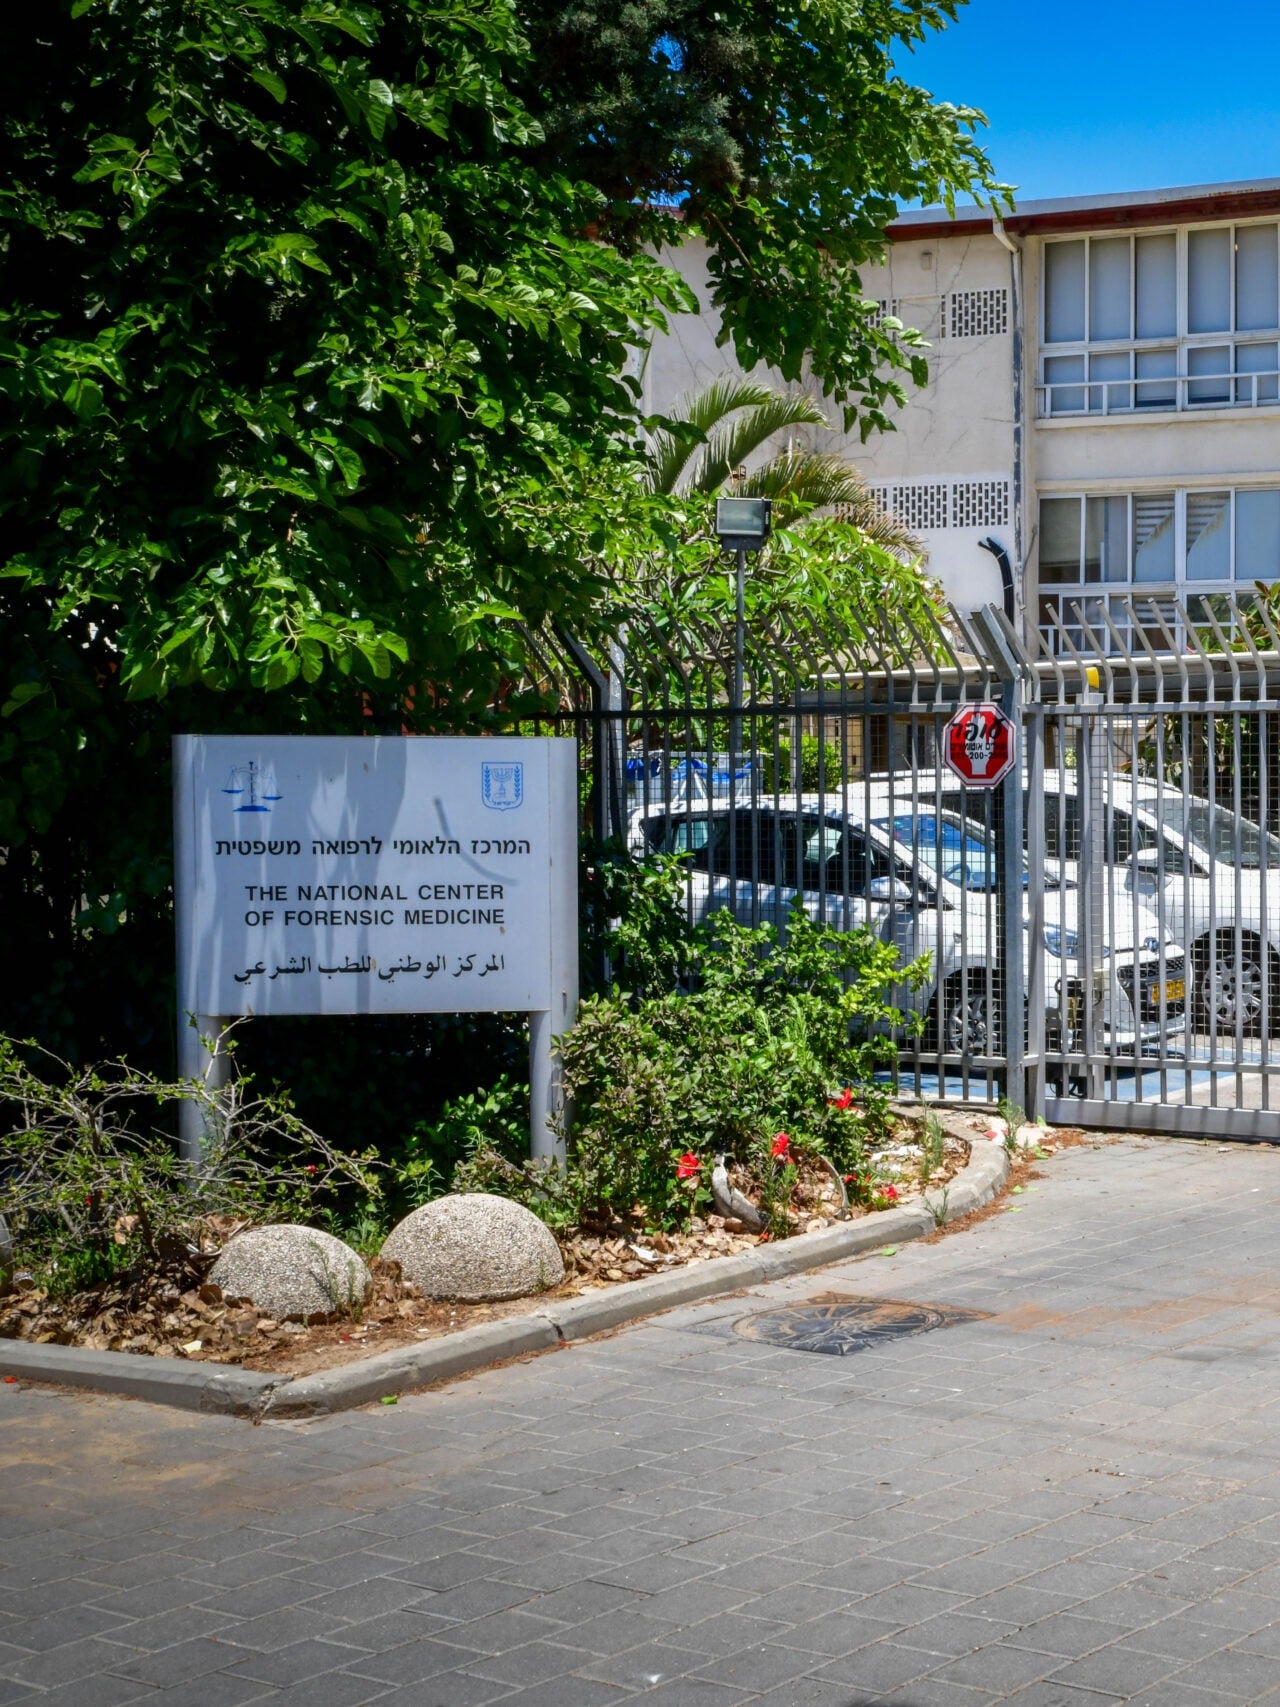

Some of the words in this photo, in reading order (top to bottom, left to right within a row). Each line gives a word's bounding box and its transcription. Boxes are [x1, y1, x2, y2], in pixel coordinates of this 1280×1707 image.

[951, 718, 1006, 742] עופר
[985, 742, 1008, 751] רים
[215, 840, 301, 856] משפטית
[312, 835, 383, 856] לרפואה
[393, 836, 461, 855] הלאומי
[471, 839, 531, 855] המרכז
[245, 885, 288, 902] THE
[298, 884, 408, 901] NATIONAL
[418, 884, 504, 901] CENTER
[244, 910, 275, 927] OF
[284, 909, 395, 927] FORENSIC
[404, 908, 505, 926] MEDICINE
[234, 956, 312, 985] الشرعي
[318, 954, 371, 980] للطب
[378, 954, 447, 984] الوطني
[453, 953, 505, 978] المركز
